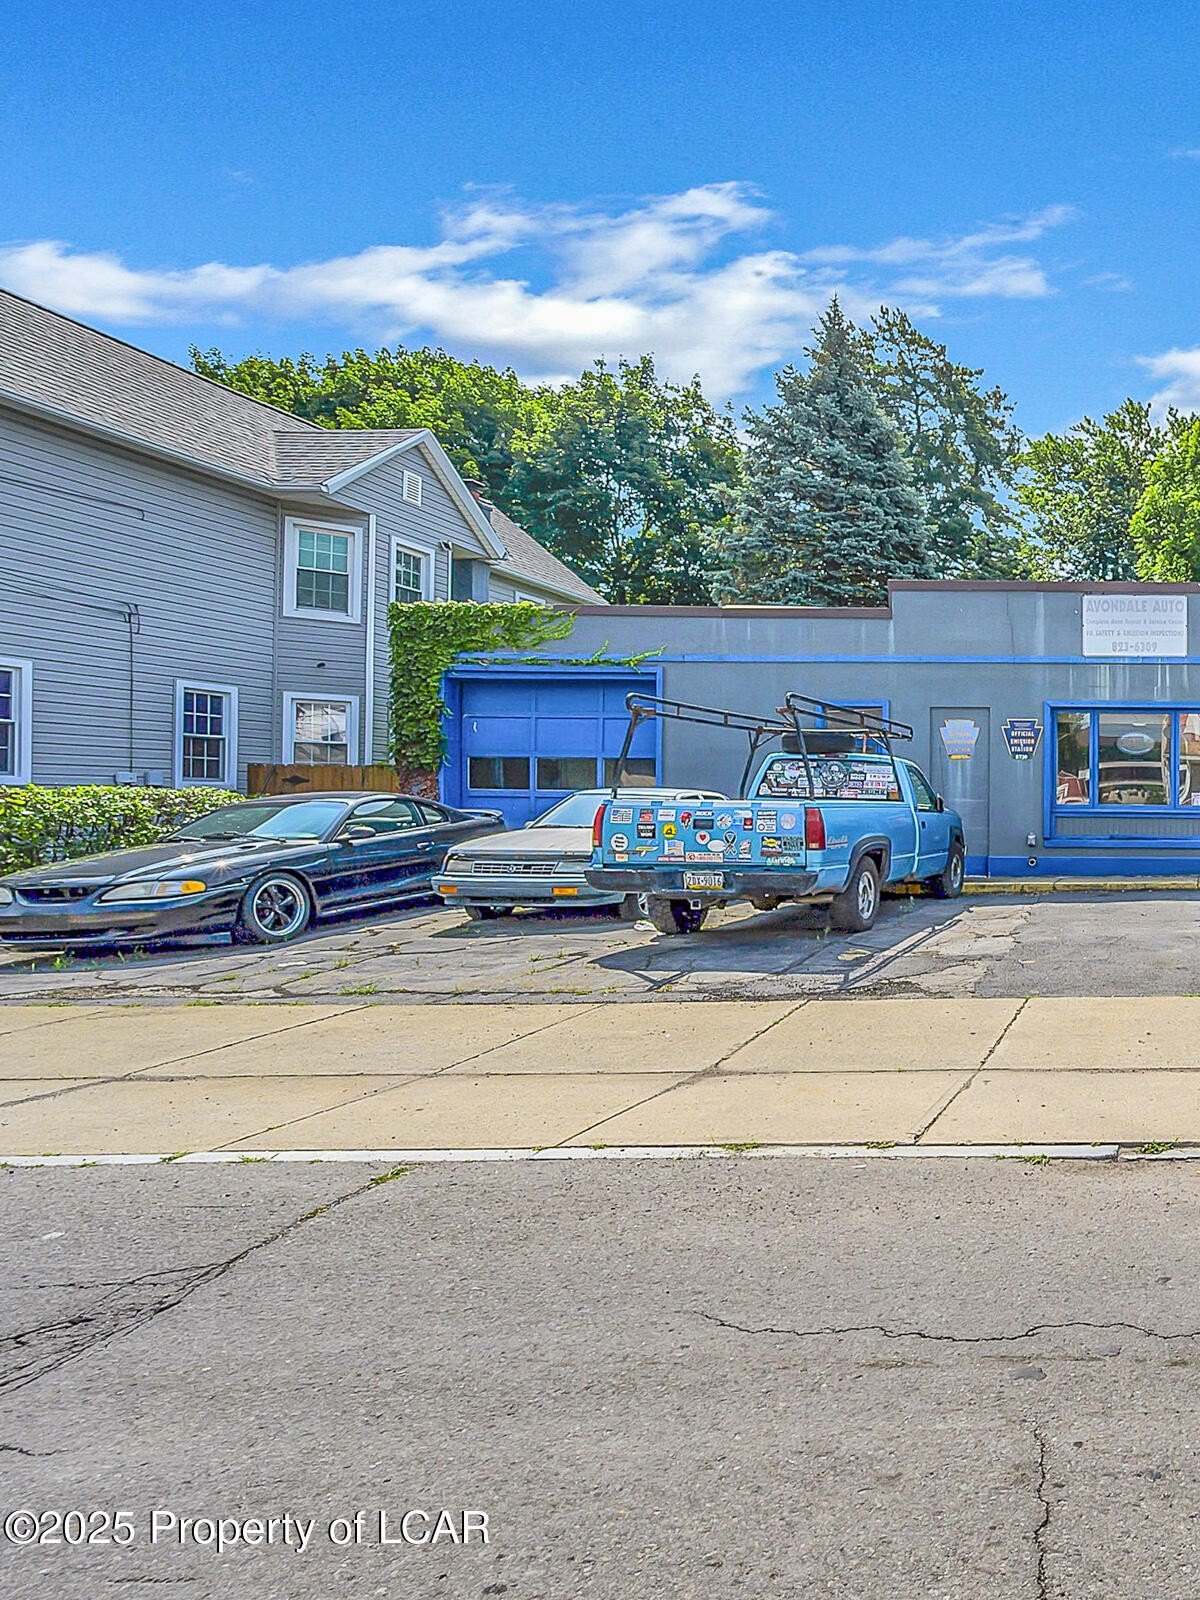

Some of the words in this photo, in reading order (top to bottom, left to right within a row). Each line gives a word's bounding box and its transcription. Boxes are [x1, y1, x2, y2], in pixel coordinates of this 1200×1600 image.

[1086, 600, 1147, 612] AVONDALE
[1153, 600, 1184, 612] AUTO
[1111, 642, 1158, 652] 823-6309
